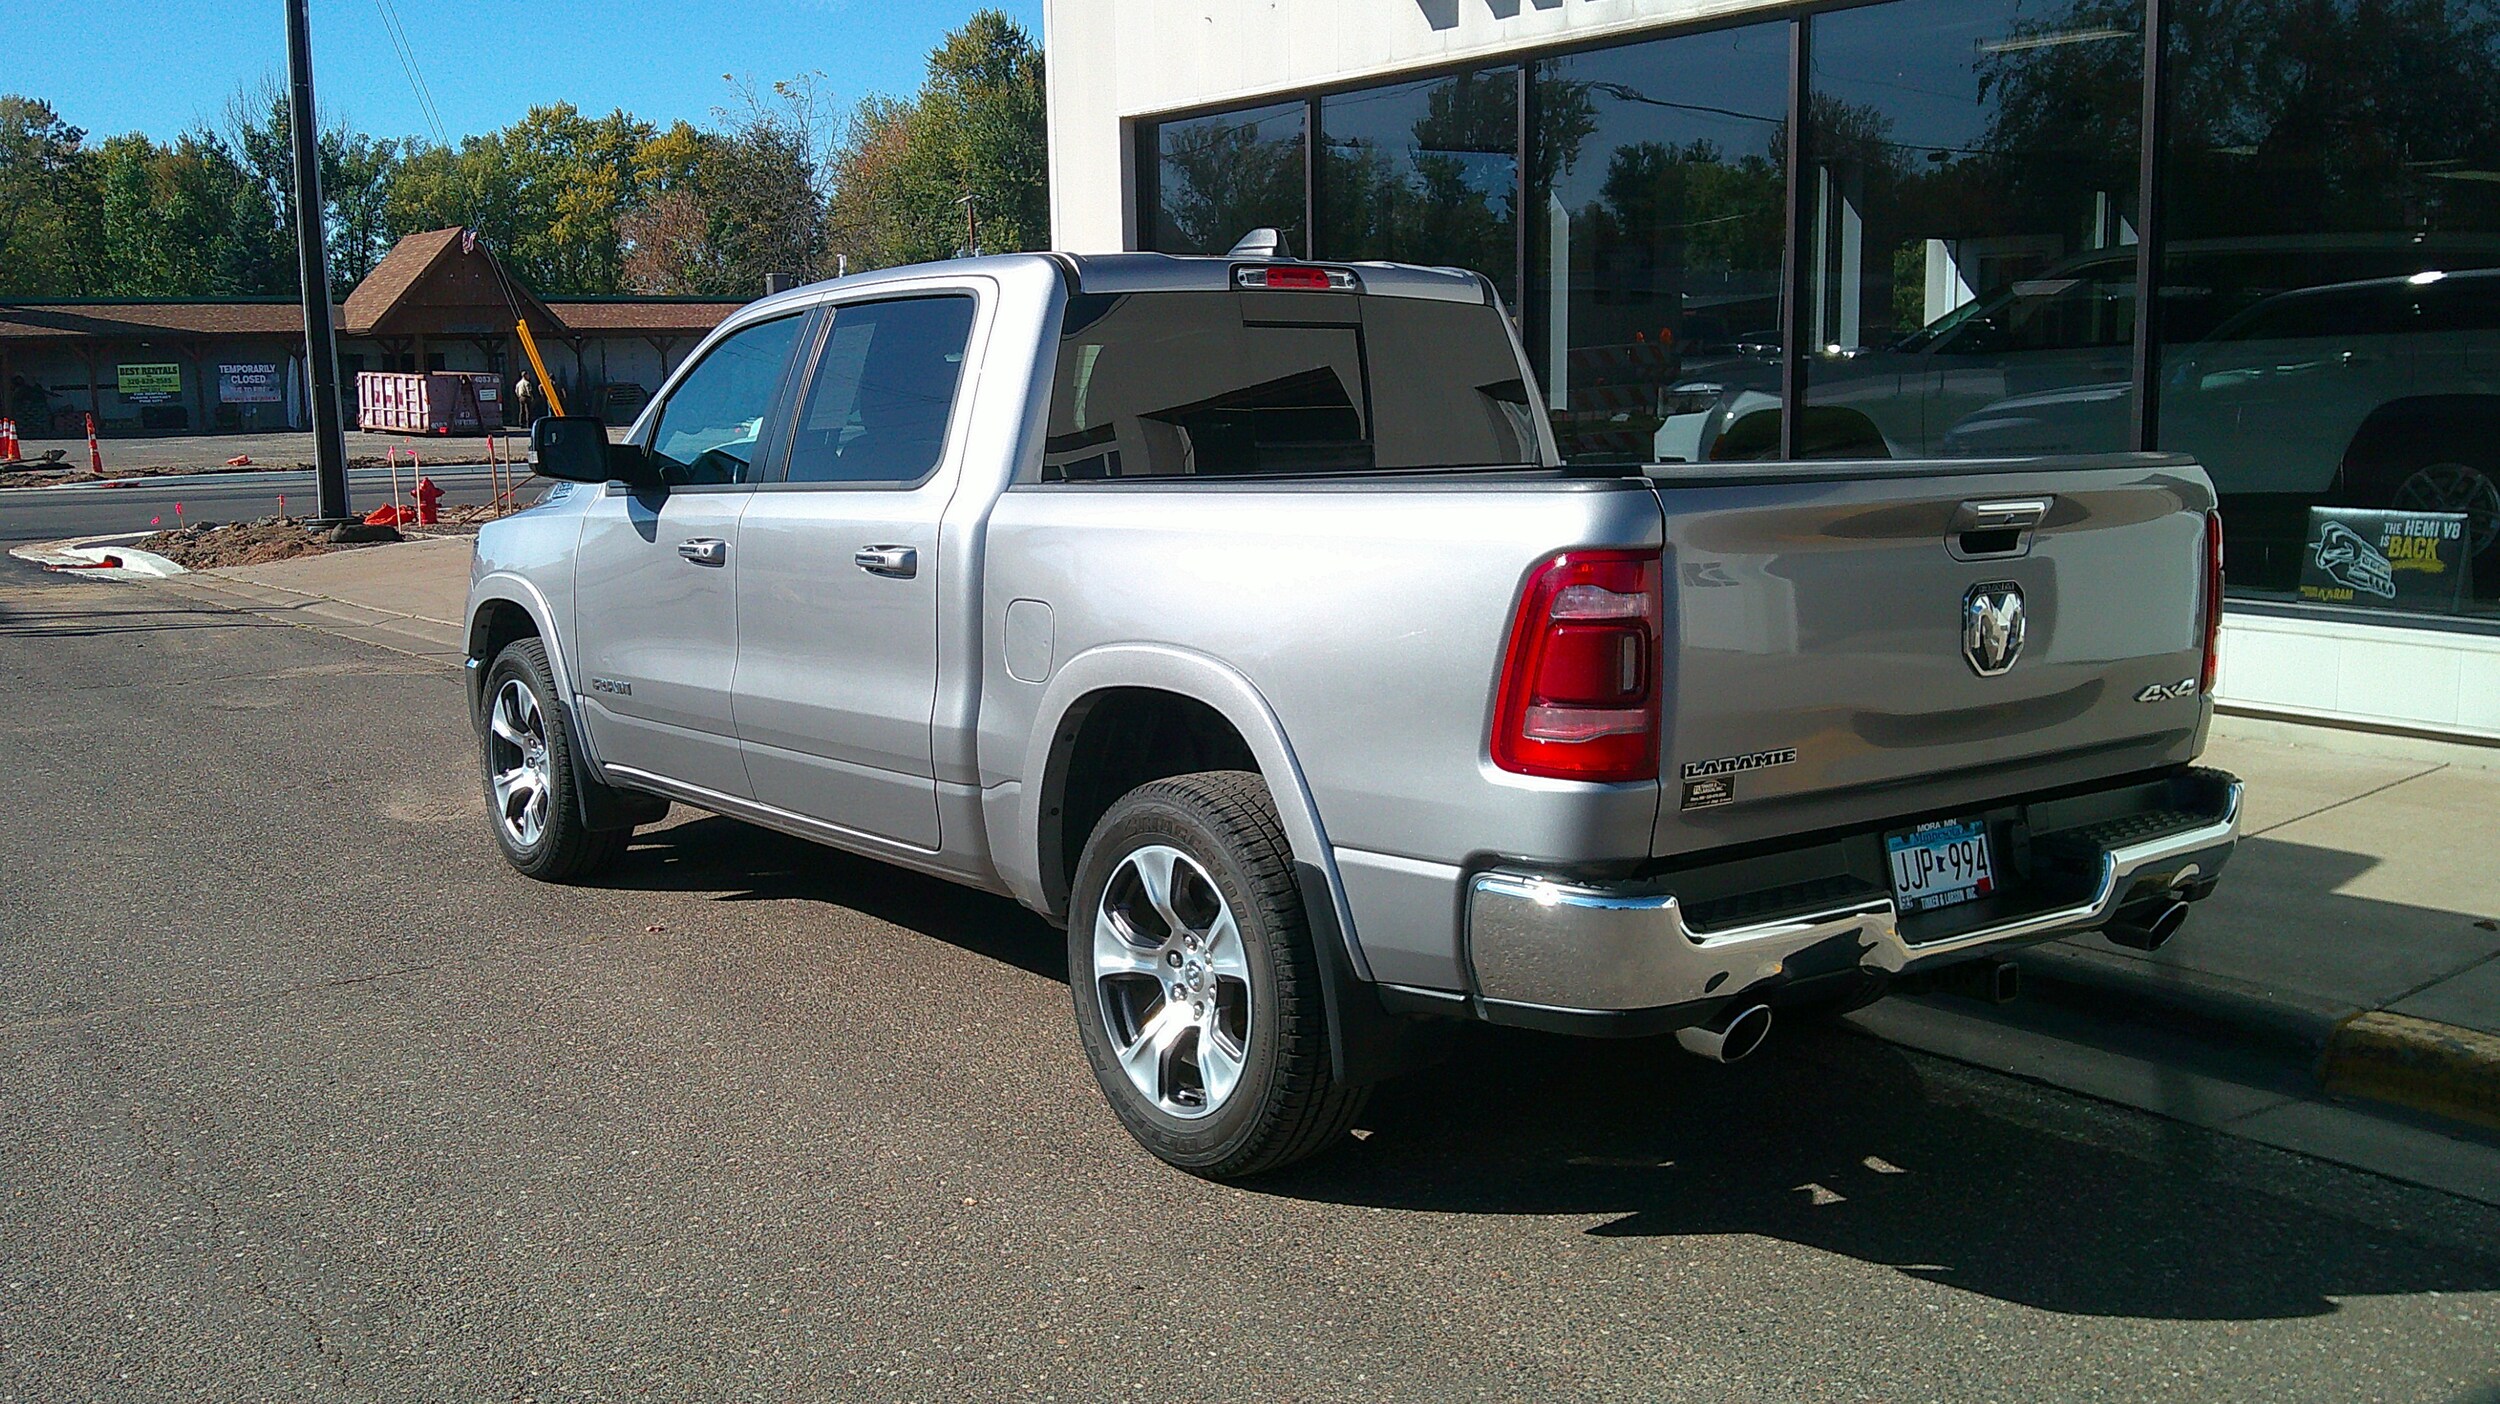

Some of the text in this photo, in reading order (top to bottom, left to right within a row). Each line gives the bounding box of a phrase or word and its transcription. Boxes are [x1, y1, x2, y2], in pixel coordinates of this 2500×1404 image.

[119, 366, 178, 376] BEST RENTALS
[218, 363, 276, 374] TEMPORARILY
[230, 374, 267, 384] CLOSED
[2384, 519, 2462, 540] THE HEMI V8
[2379, 534, 2440, 560] IS BACK
[1683, 748, 1797, 779] LARAMIE
[1917, 818, 1957, 832] MORA MN
[1898, 837, 1988, 892] JJP 994
